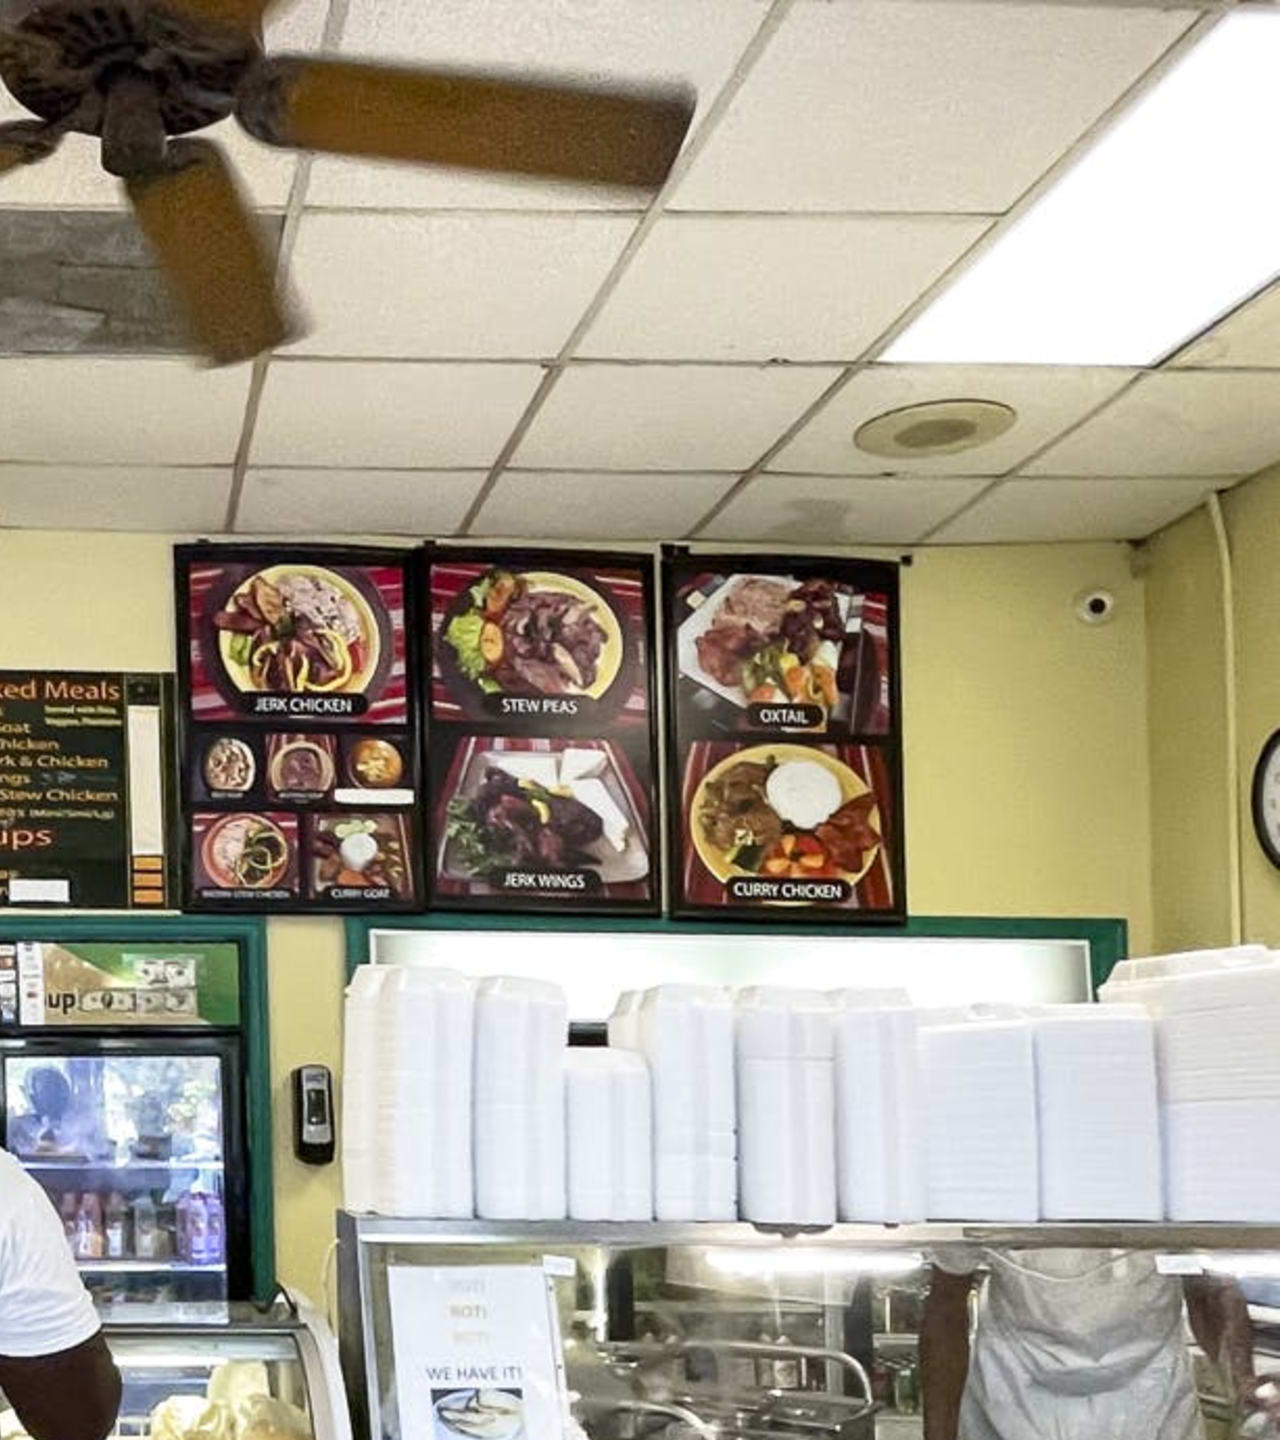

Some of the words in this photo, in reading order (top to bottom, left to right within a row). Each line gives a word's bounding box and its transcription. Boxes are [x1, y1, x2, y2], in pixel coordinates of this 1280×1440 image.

[44, 680, 121, 700] Meals
[254, 698, 288, 713] JERK
[290, 698, 352, 713] CHICKEN
[502, 699, 539, 713] STEW
[542, 700, 578, 714] PEAS
[760, 708, 809, 723] OXTAIL
[36, 756, 109, 768] Chicken
[46, 790, 118, 801] Chicken
[504, 873, 537, 887] JERK
[539, 874, 585, 889] WINGS
[733, 882, 780, 897] CURRY
[782, 883, 841, 898] CHICKEN
[426, 1367, 451, 1381] WE
[456, 1366, 497, 1381] HAVE
